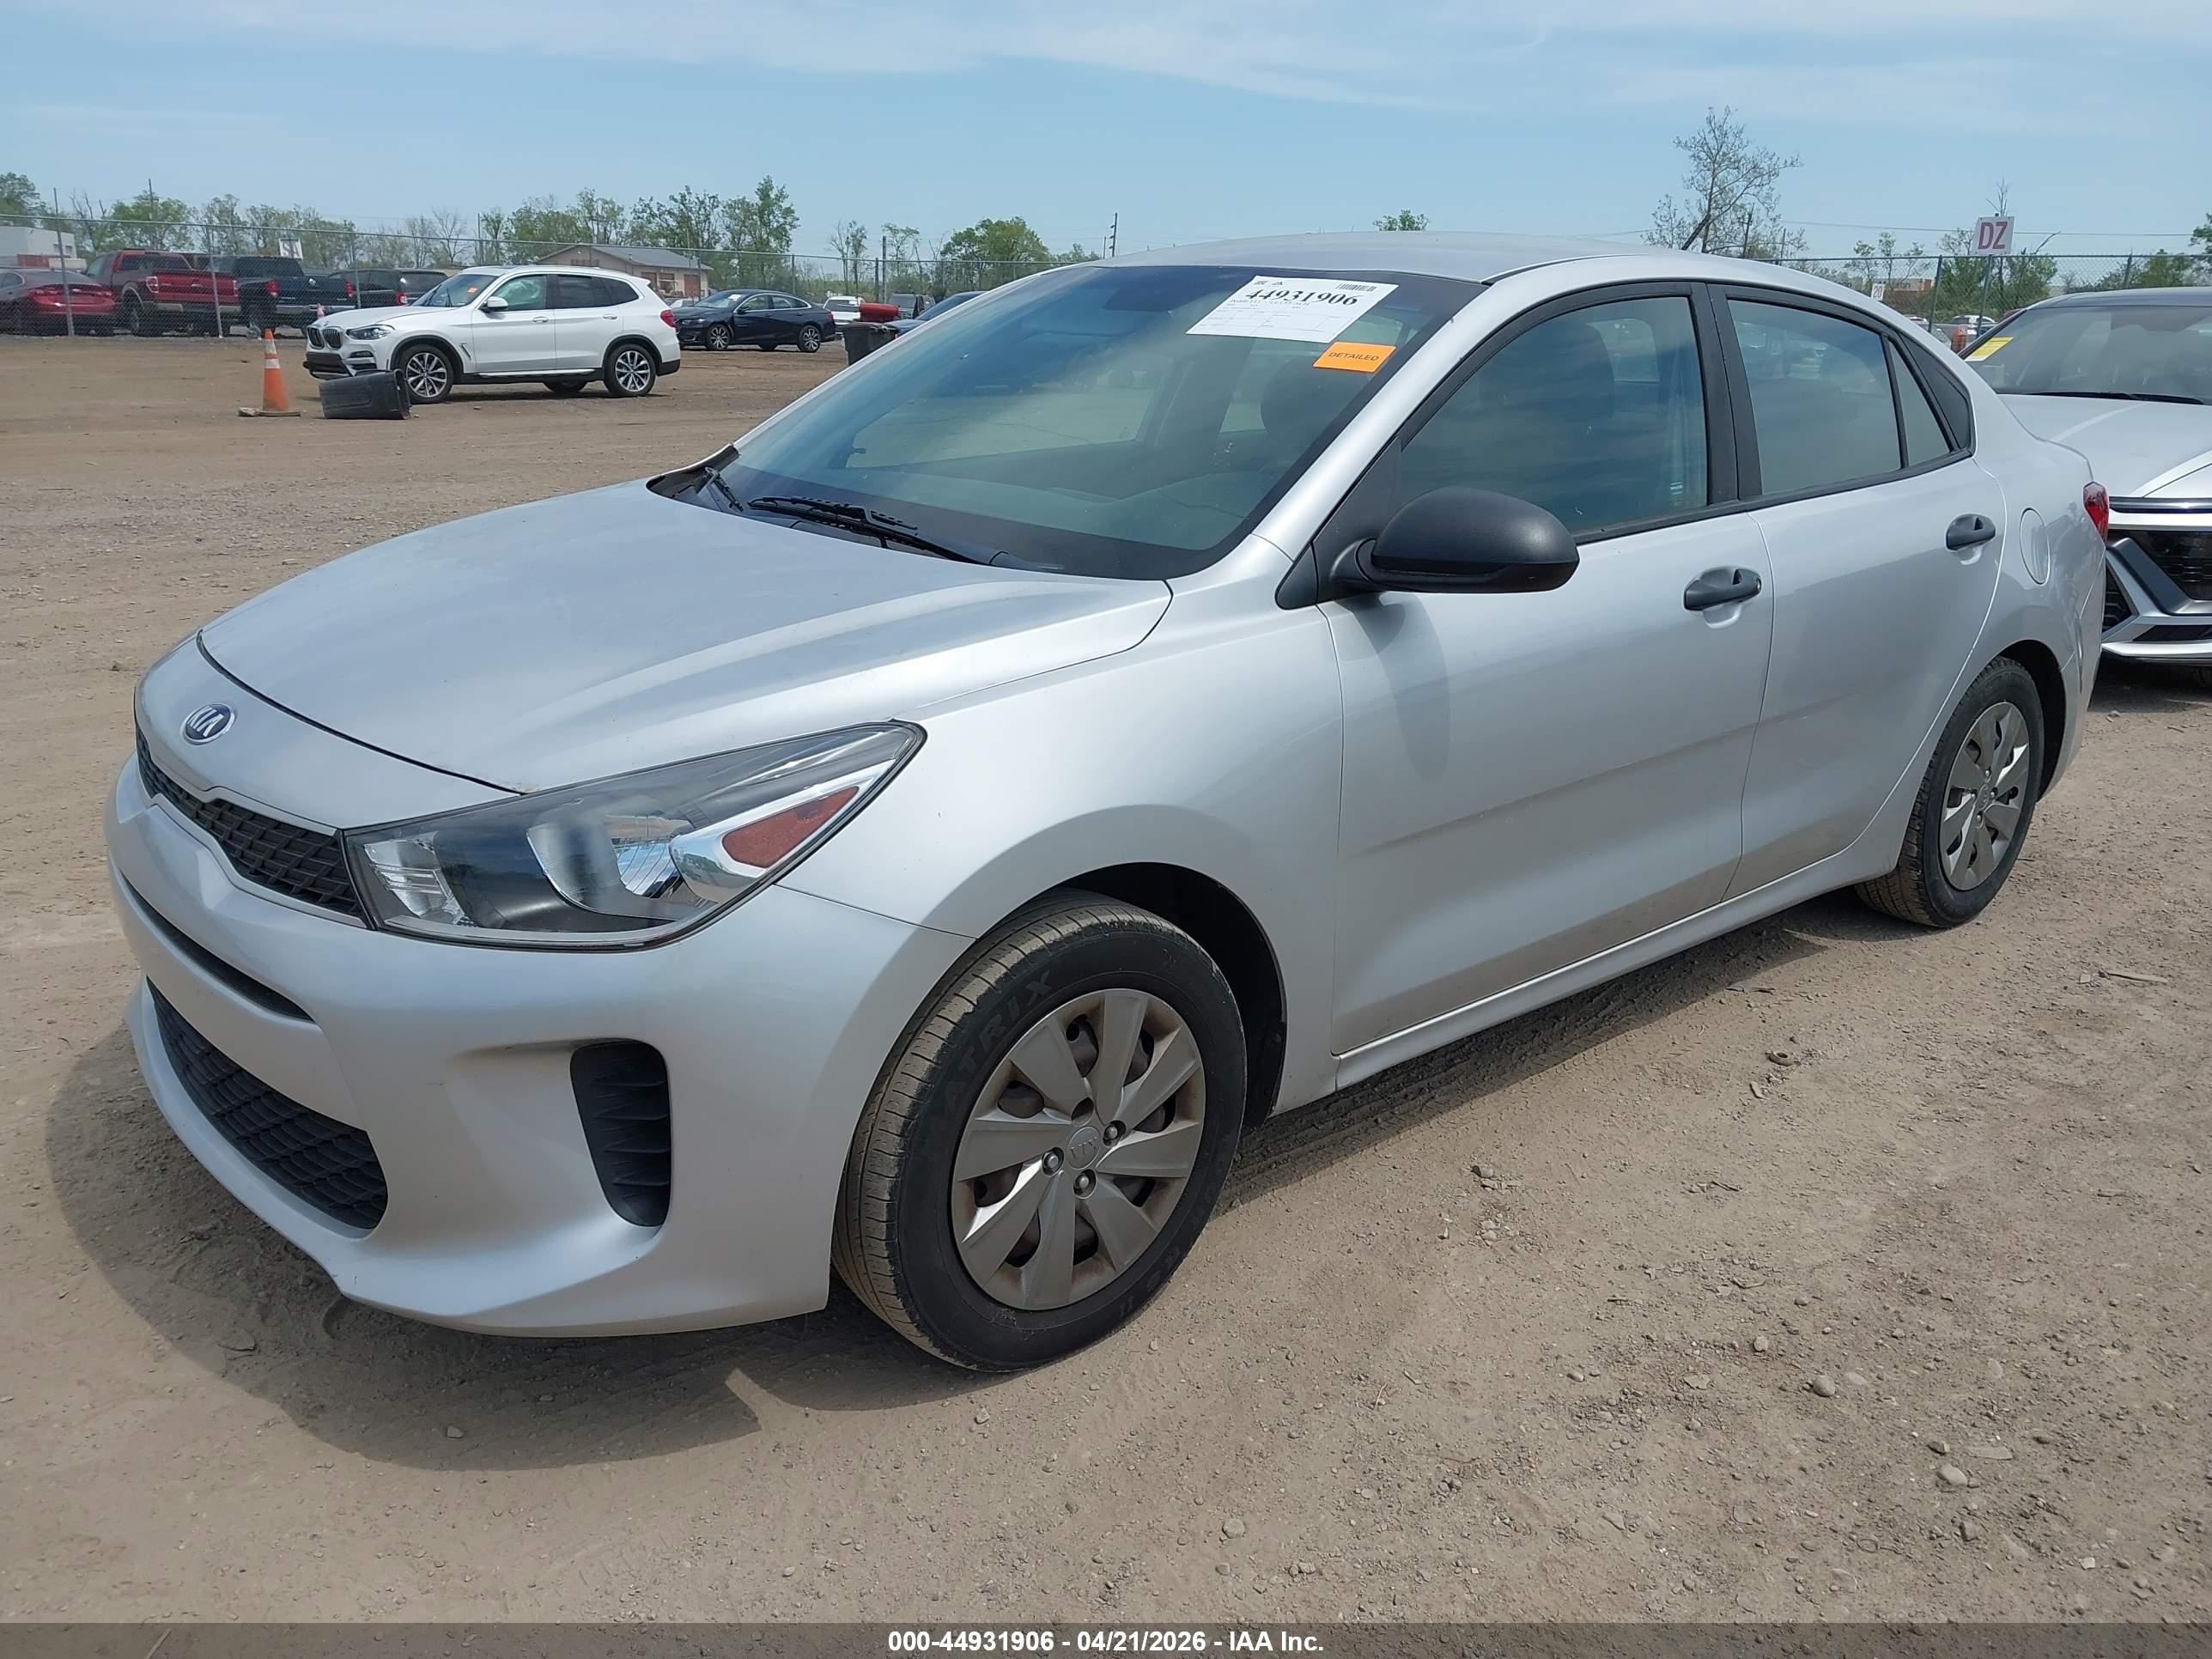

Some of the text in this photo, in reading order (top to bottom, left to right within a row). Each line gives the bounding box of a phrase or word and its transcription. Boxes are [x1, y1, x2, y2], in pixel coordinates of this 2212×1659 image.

[1978, 221, 2008, 250] DZ
[1245, 289, 1364, 306] 44931906
[1328, 352, 1379, 361] DETAILED
